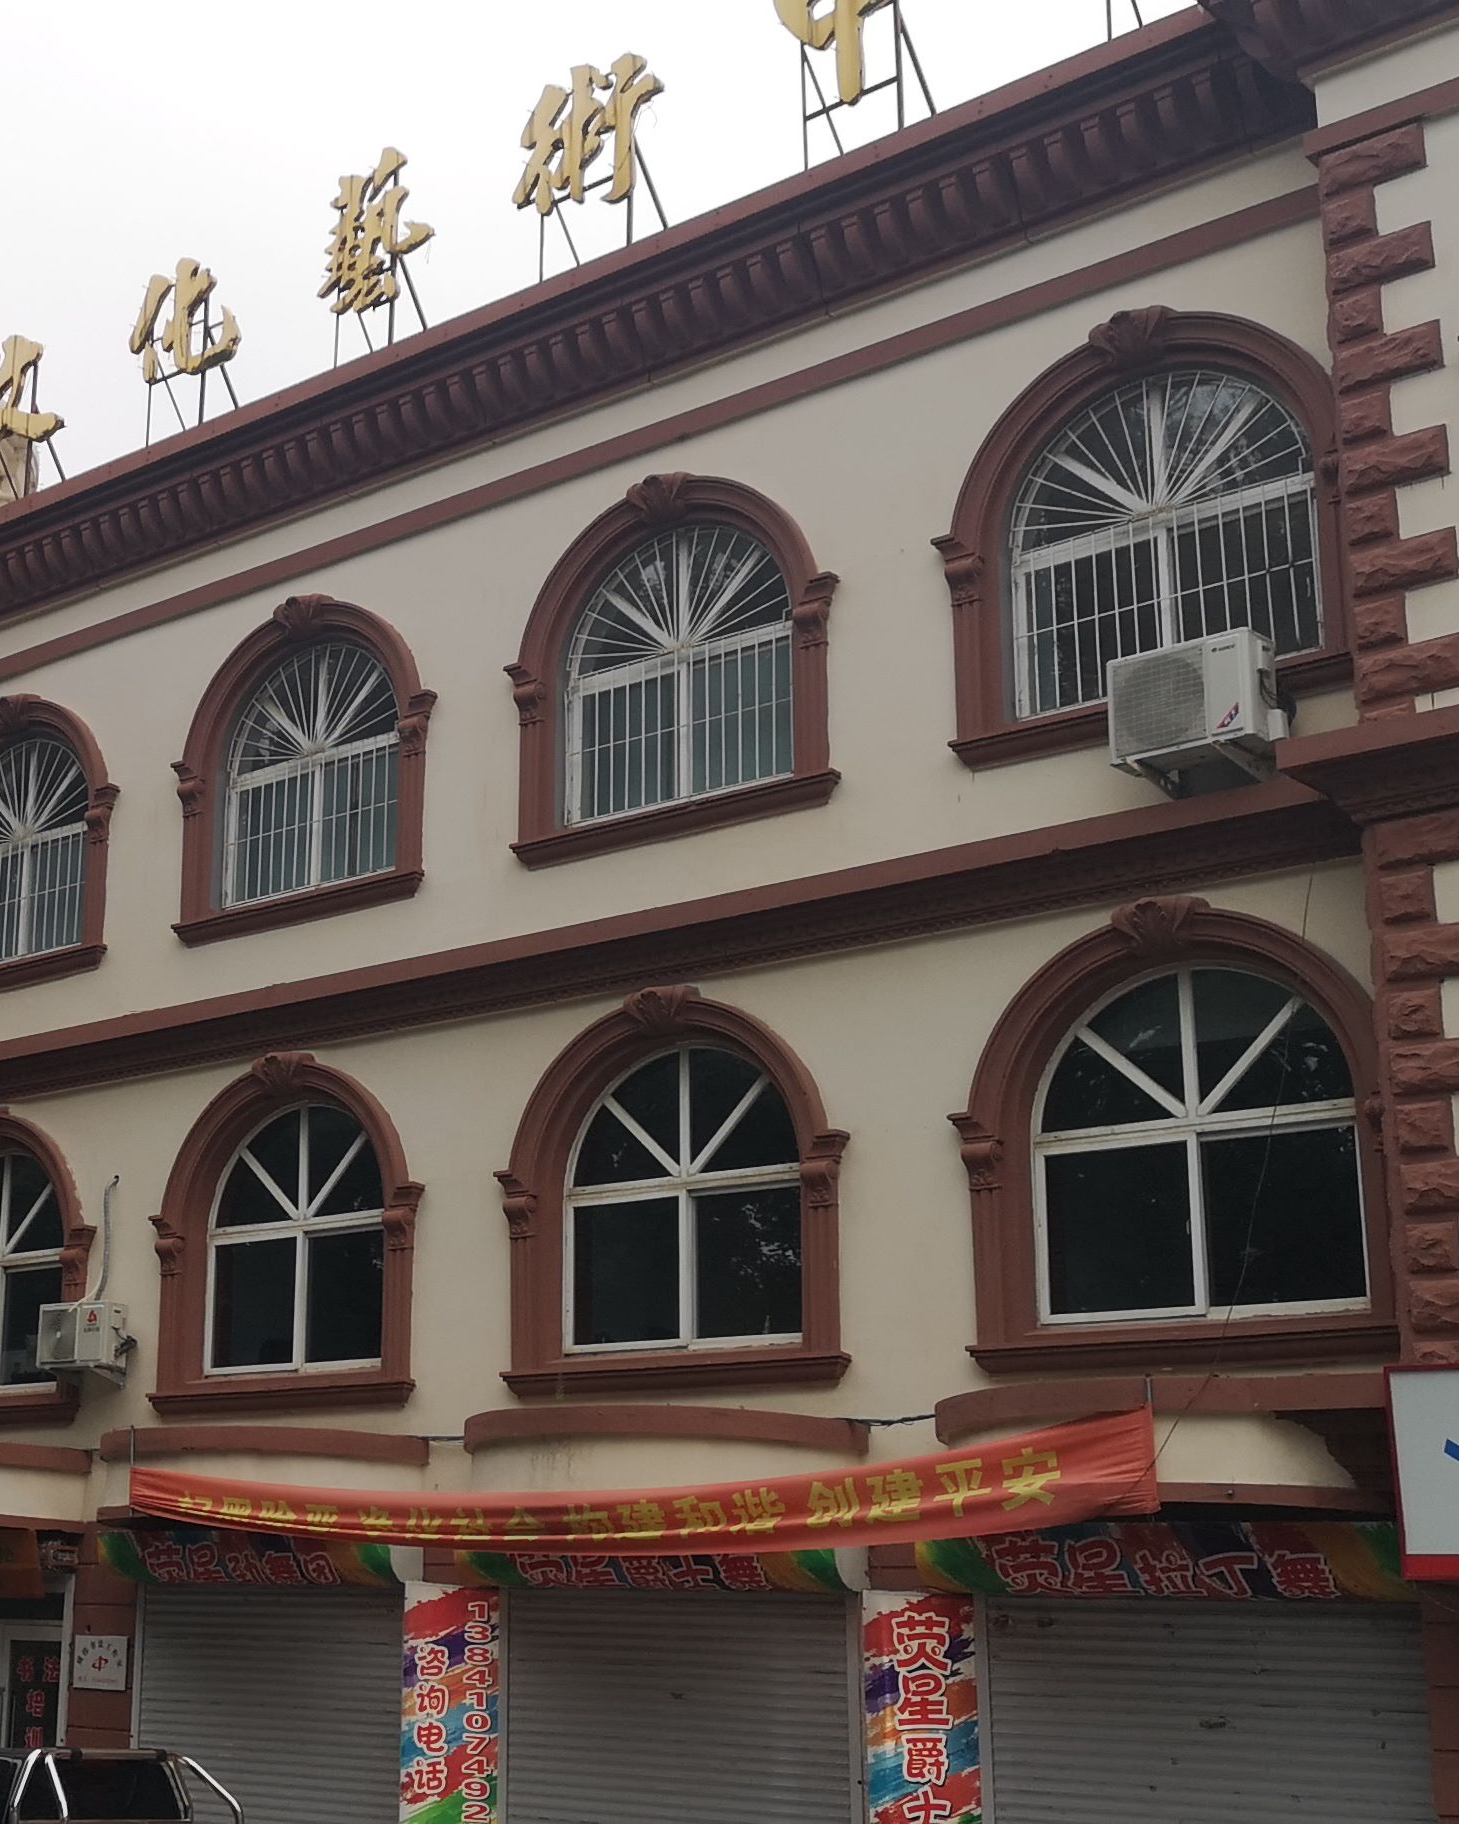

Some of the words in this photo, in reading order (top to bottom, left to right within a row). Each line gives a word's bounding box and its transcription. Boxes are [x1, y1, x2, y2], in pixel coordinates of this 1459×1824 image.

[805, 1445, 1063, 1529] 创建平安
[413, 1646, 449, 1793] 咨询电话
[460, 1600, 492, 1824] 1384107492
